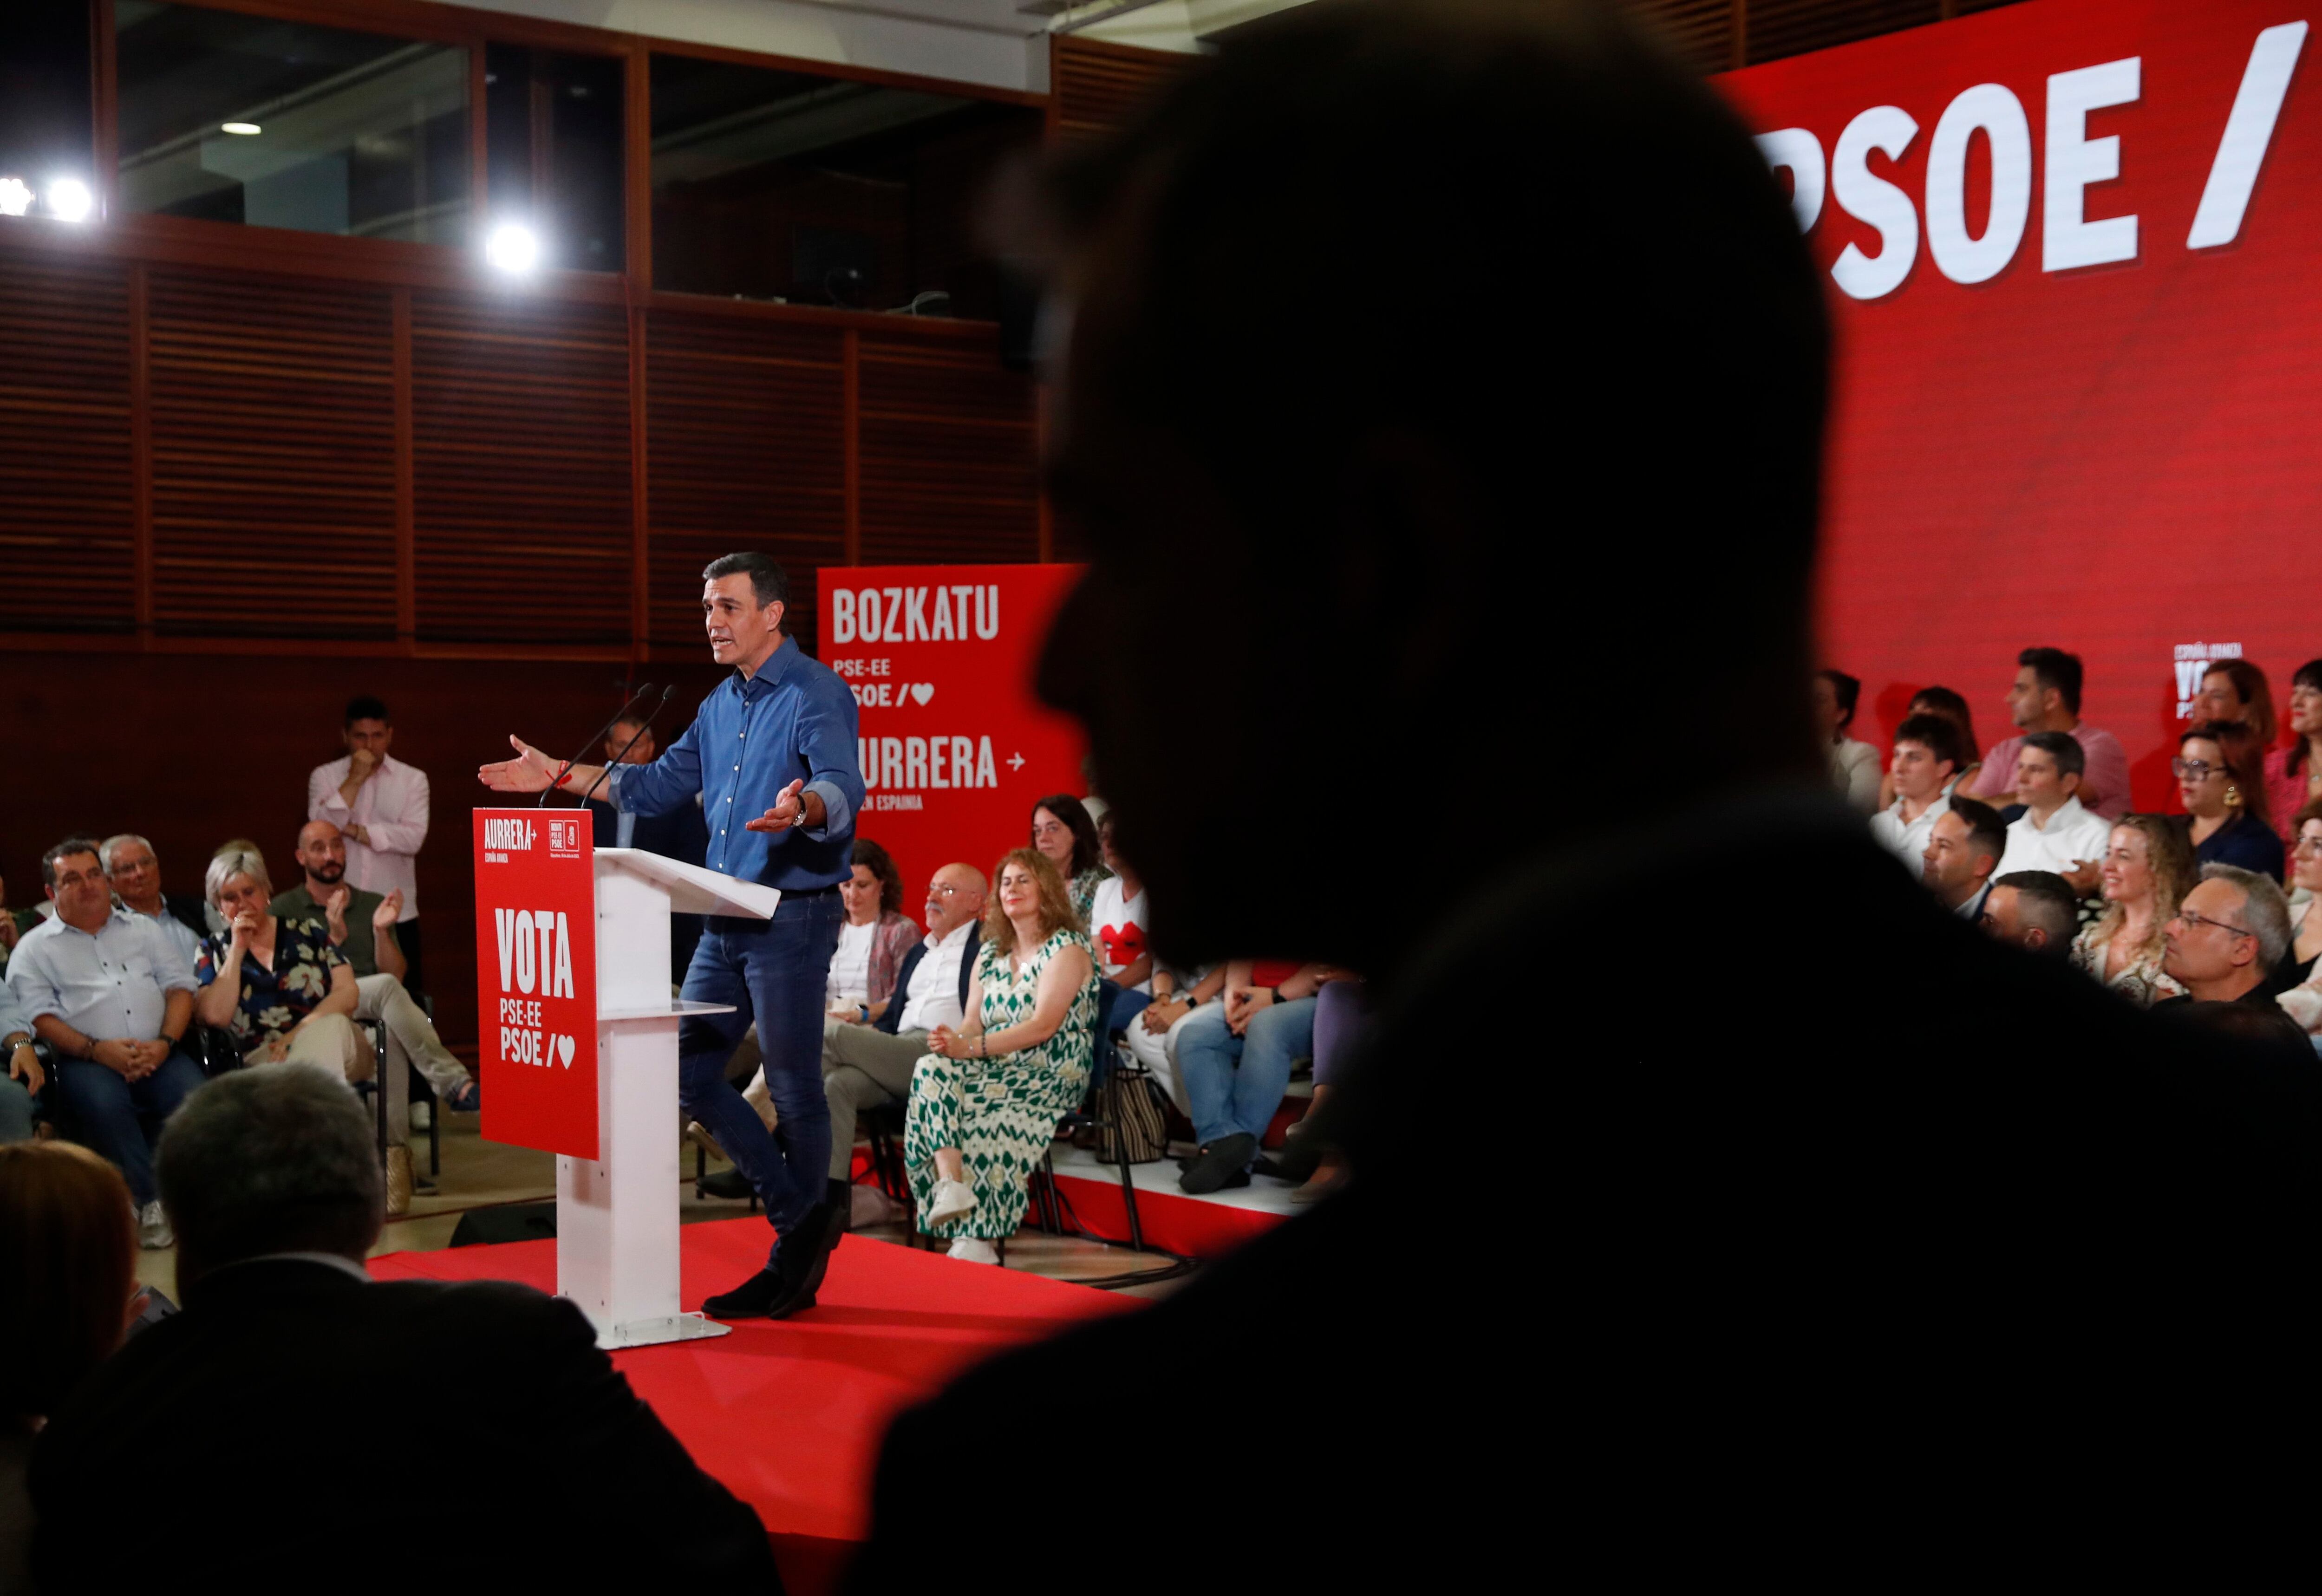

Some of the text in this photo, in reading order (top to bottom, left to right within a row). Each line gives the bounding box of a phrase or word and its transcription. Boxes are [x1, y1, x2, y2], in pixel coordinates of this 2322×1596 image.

[833, 585, 999, 643] BOZKATU
[833, 658, 891, 677] PSE-EE
[850, 684, 892, 708] SOE
[858, 736, 998, 789] URRERA
[484, 819, 531, 850] AURRERA
[495, 908, 574, 999] VOTA
[500, 997, 542, 1028] PSE-EE
[501, 1026, 543, 1067] PSOE
